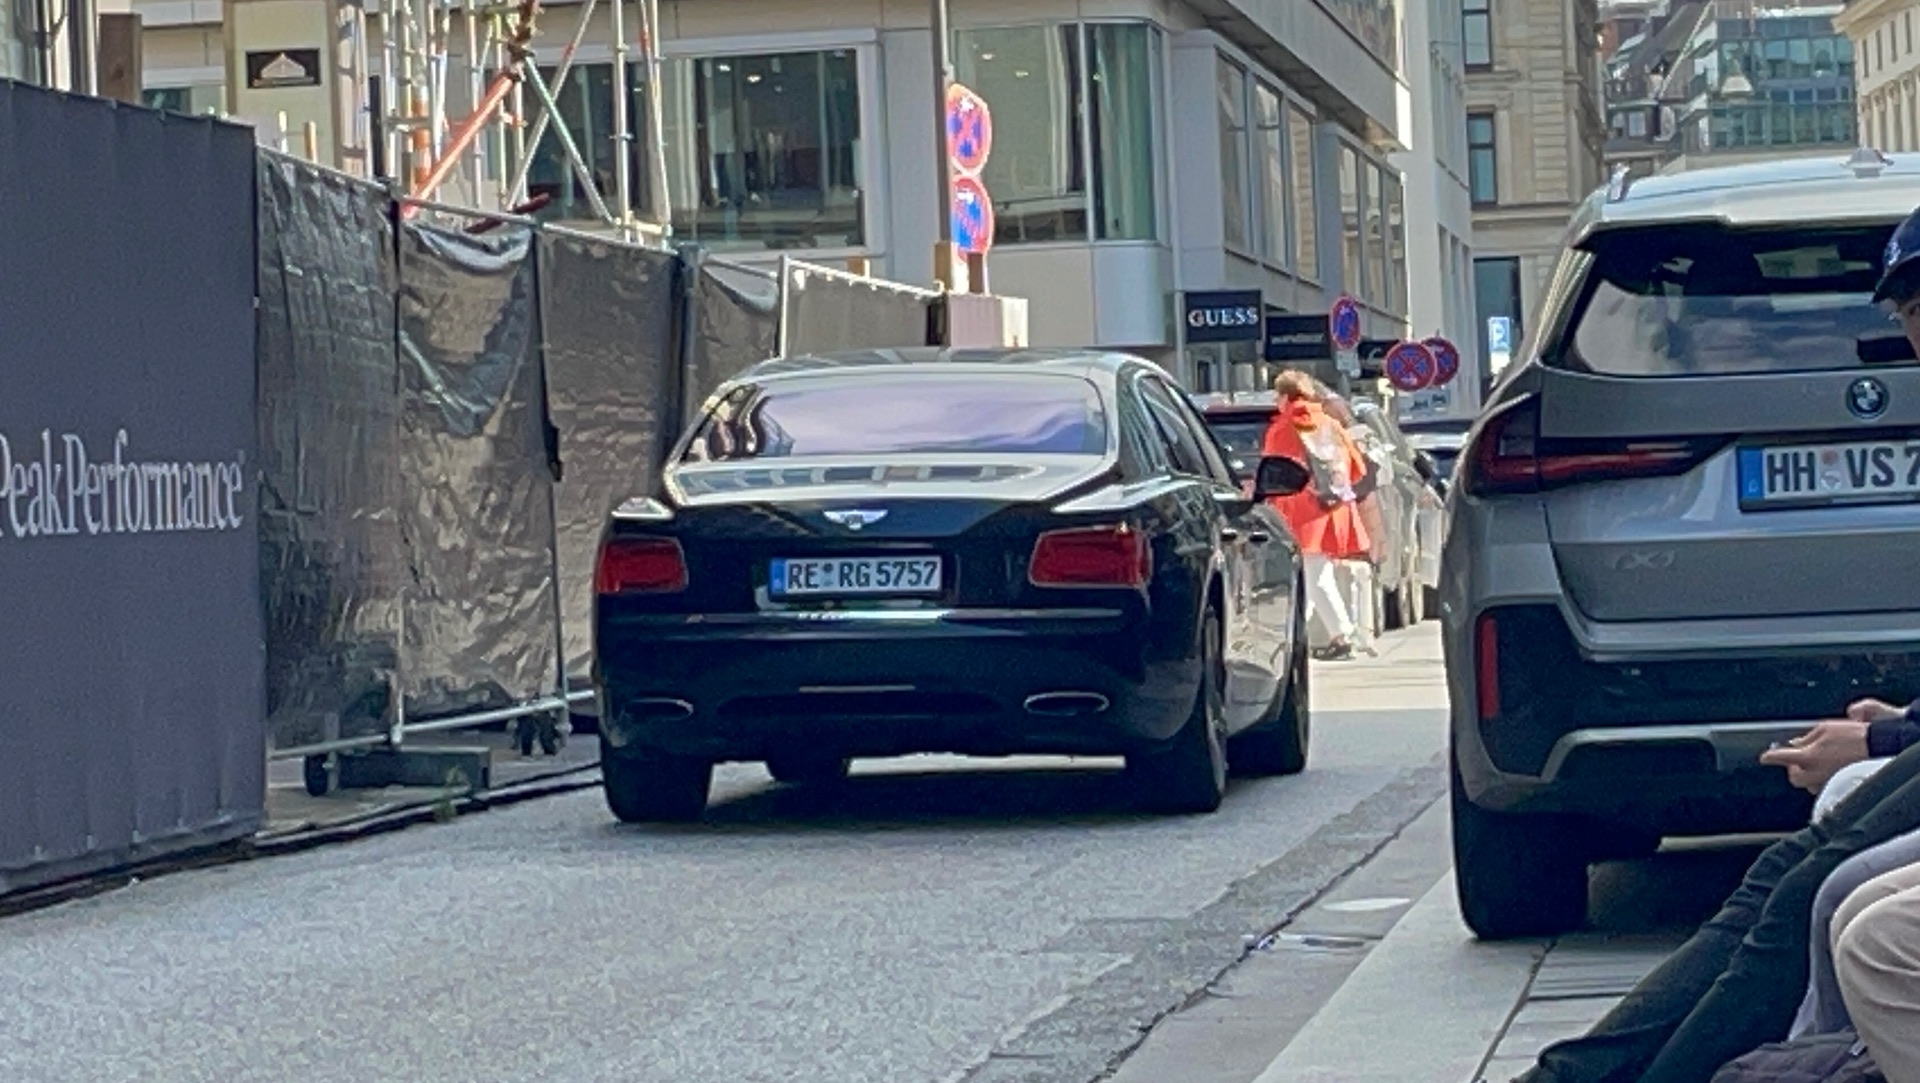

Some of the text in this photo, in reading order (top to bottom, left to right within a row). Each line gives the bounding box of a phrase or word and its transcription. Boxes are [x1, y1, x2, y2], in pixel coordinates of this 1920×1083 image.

[1187, 306, 1259, 327] GUESS
[1766, 451, 1815, 492] HH
[1845, 446, 1896, 488] VS
[787, 562, 819, 589] RE
[838, 561, 871, 587] RG
[875, 560, 938, 587] 5757
